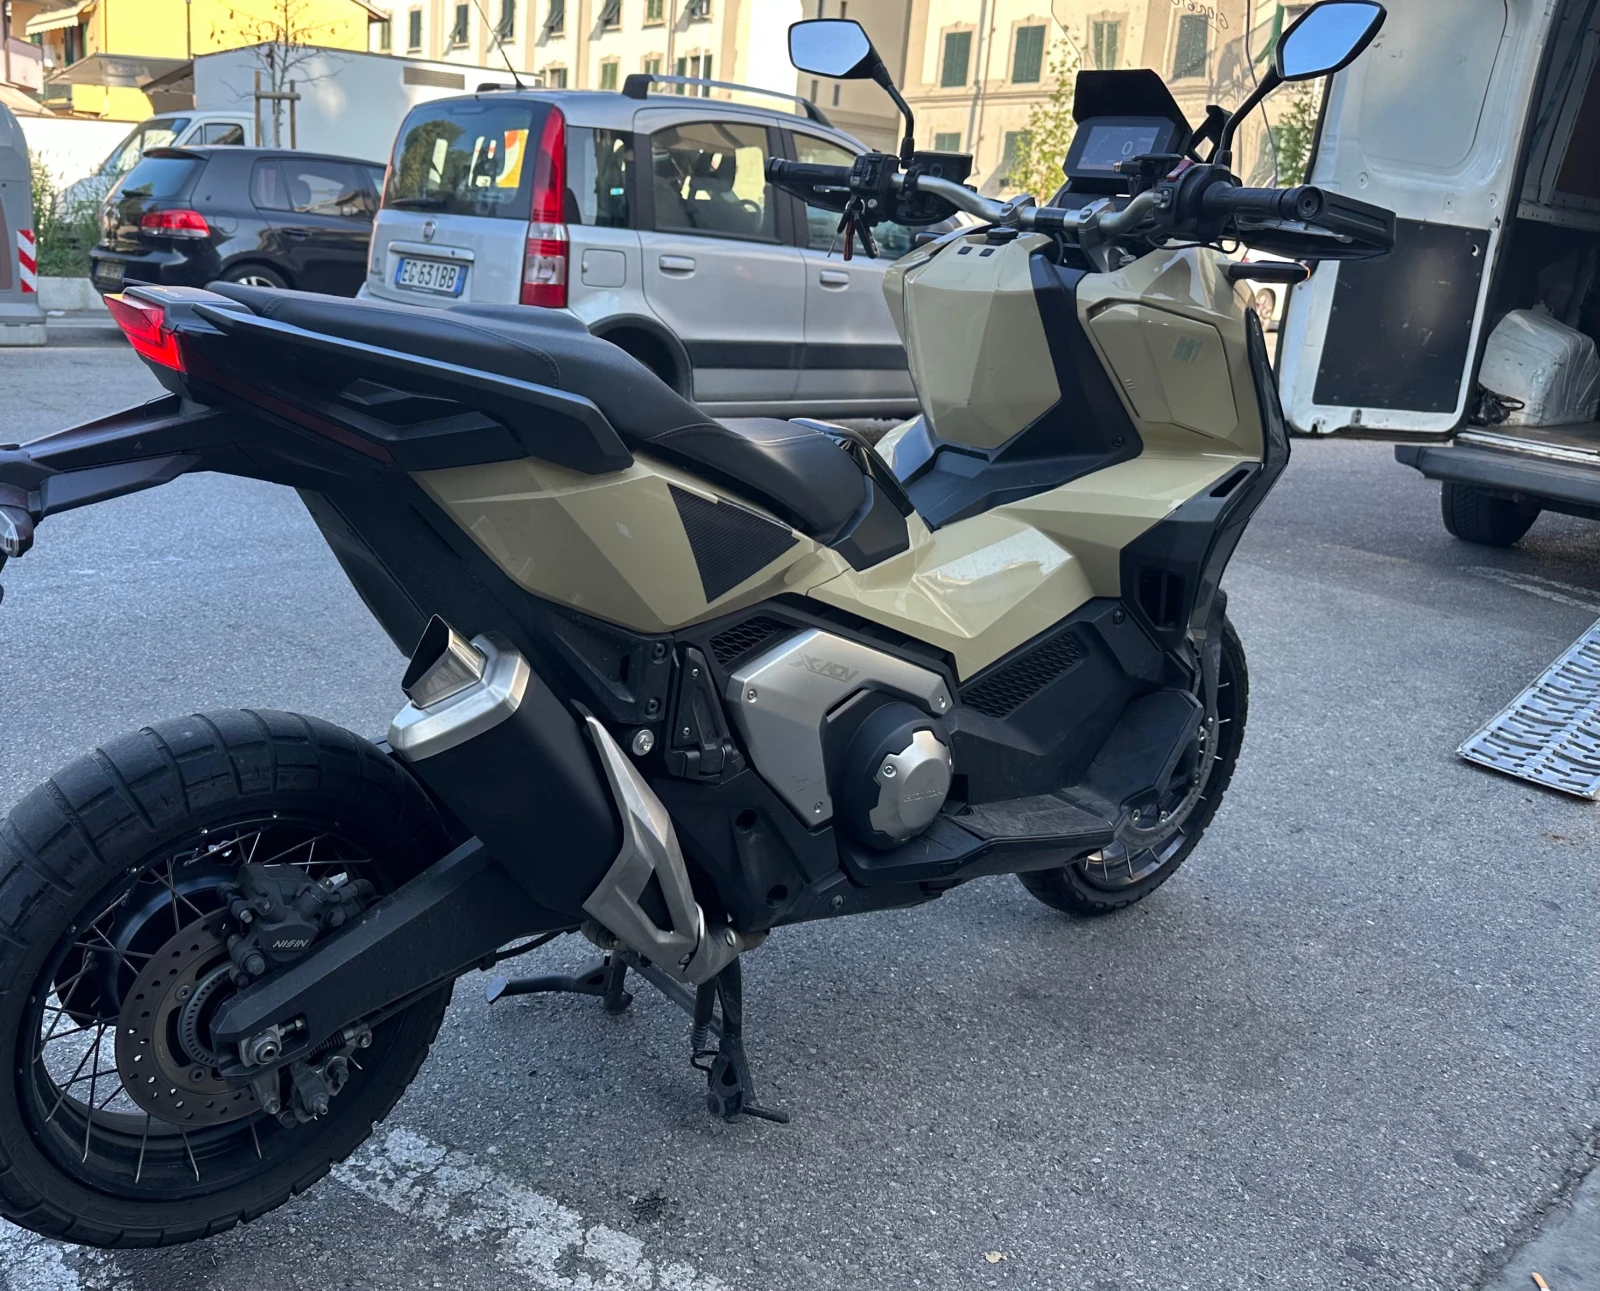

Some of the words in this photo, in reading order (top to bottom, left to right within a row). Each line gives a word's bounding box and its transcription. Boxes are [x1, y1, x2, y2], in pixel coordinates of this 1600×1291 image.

[1121, 140, 1133, 156] 0
[401, 261, 418, 282] EG
[418, 264, 456, 289] 631BB
